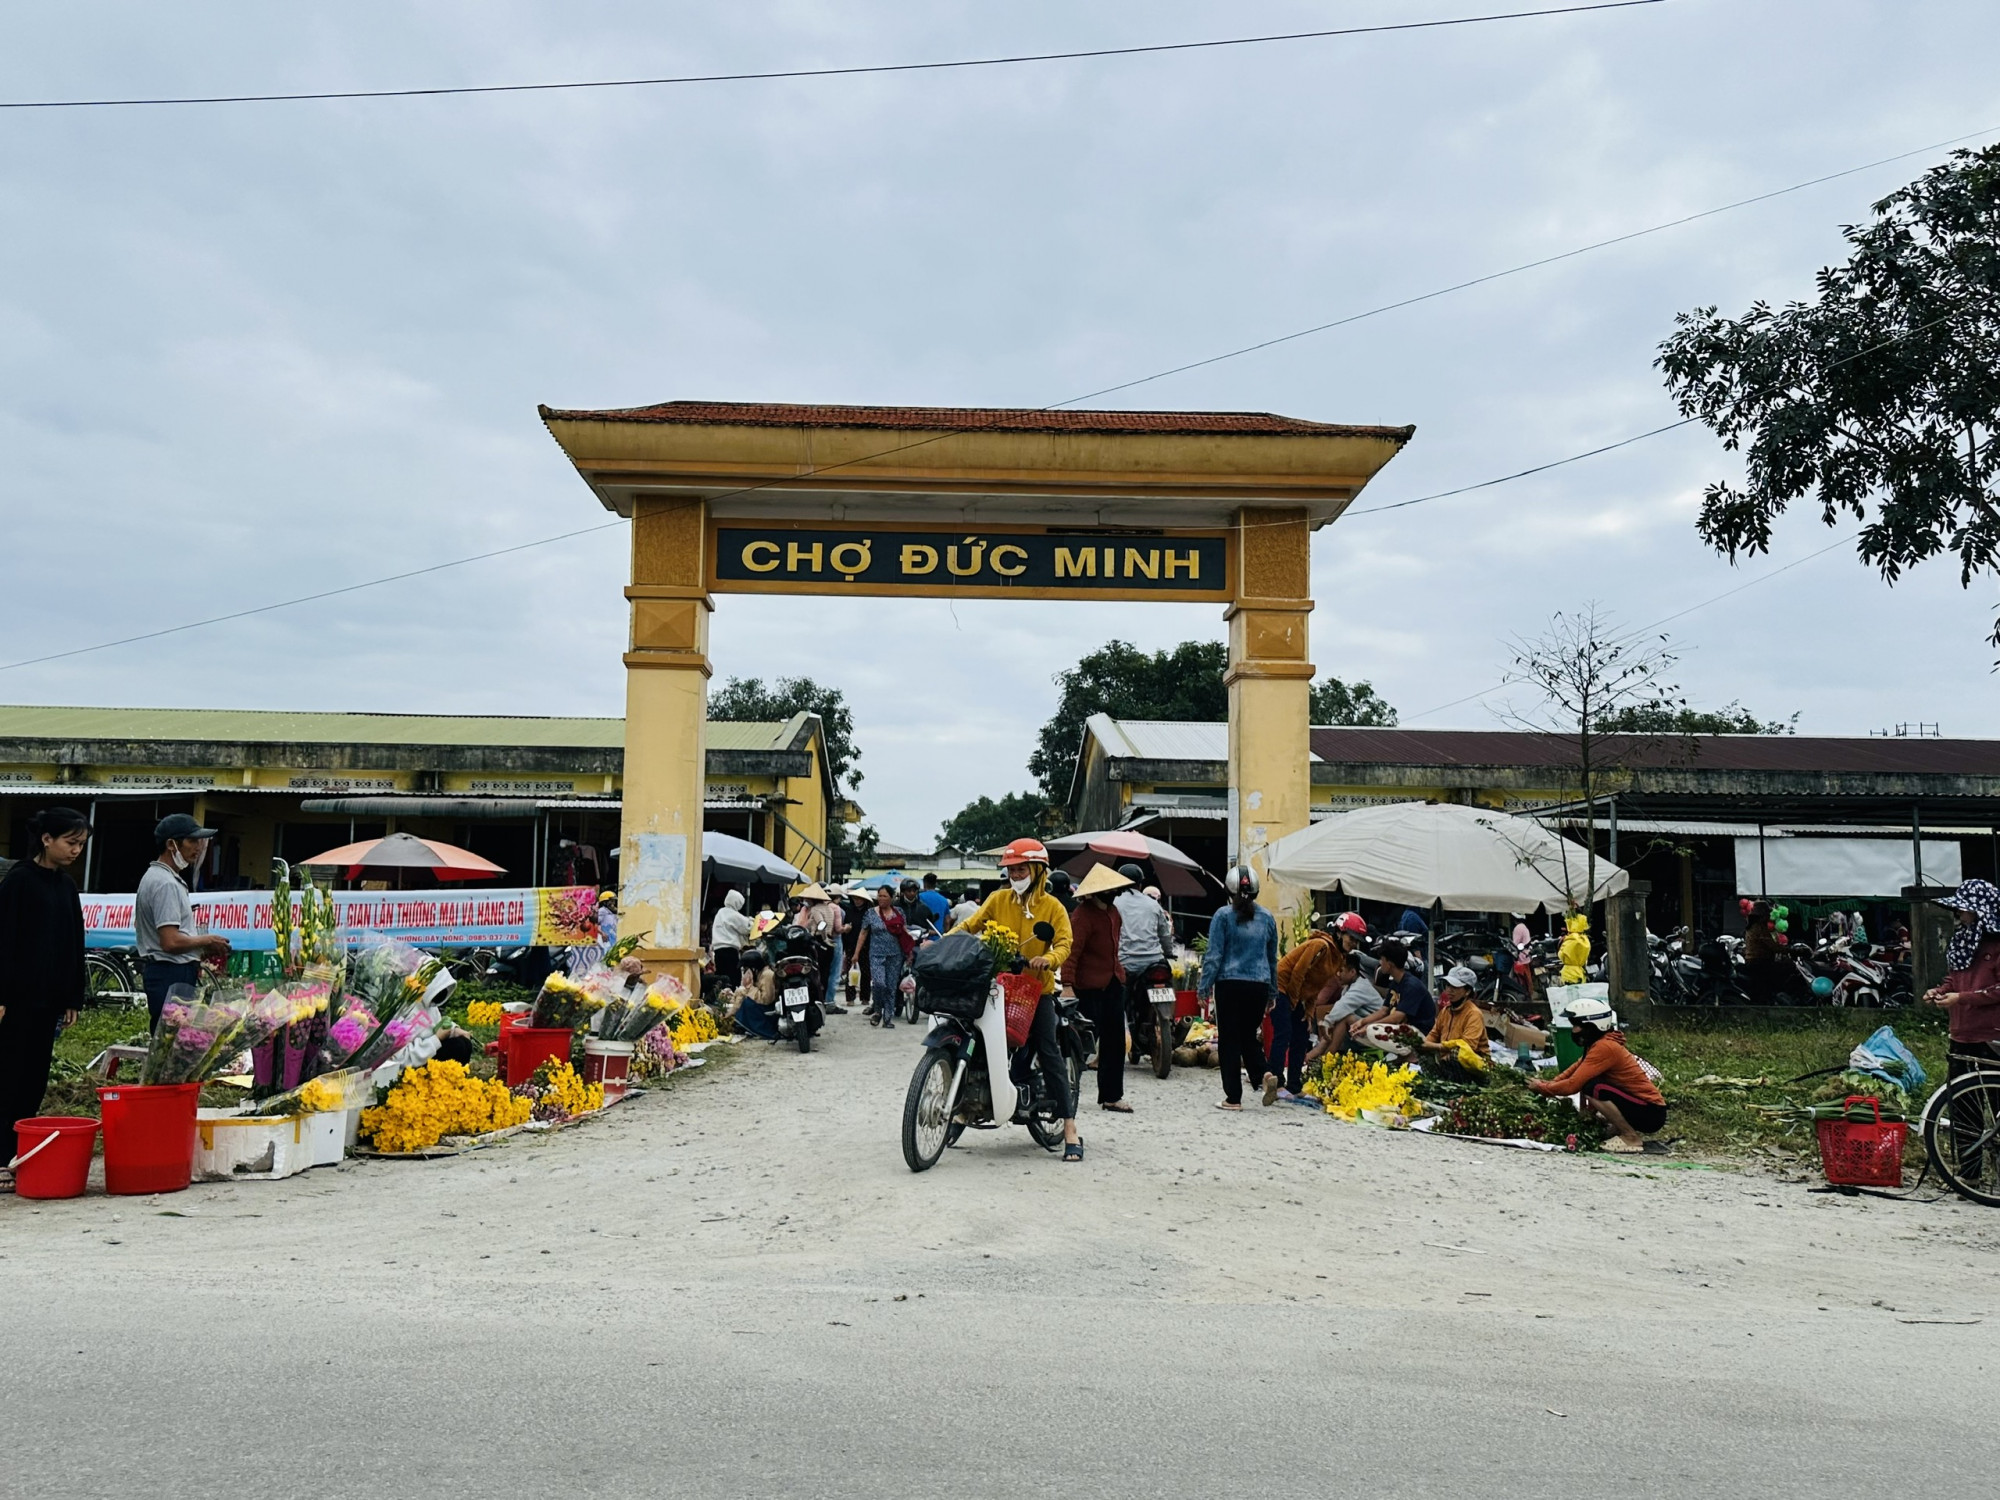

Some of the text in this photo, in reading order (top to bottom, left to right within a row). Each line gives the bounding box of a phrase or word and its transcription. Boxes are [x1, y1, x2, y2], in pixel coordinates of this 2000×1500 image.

[741, 536, 1200, 581] CHỢ ĐỨC MINH
[103, 904, 133, 928] THAM
[347, 903, 371, 928] GIAN
[462, 896, 474, 926] VÀ
[477, 896, 505, 926] HÀNG
